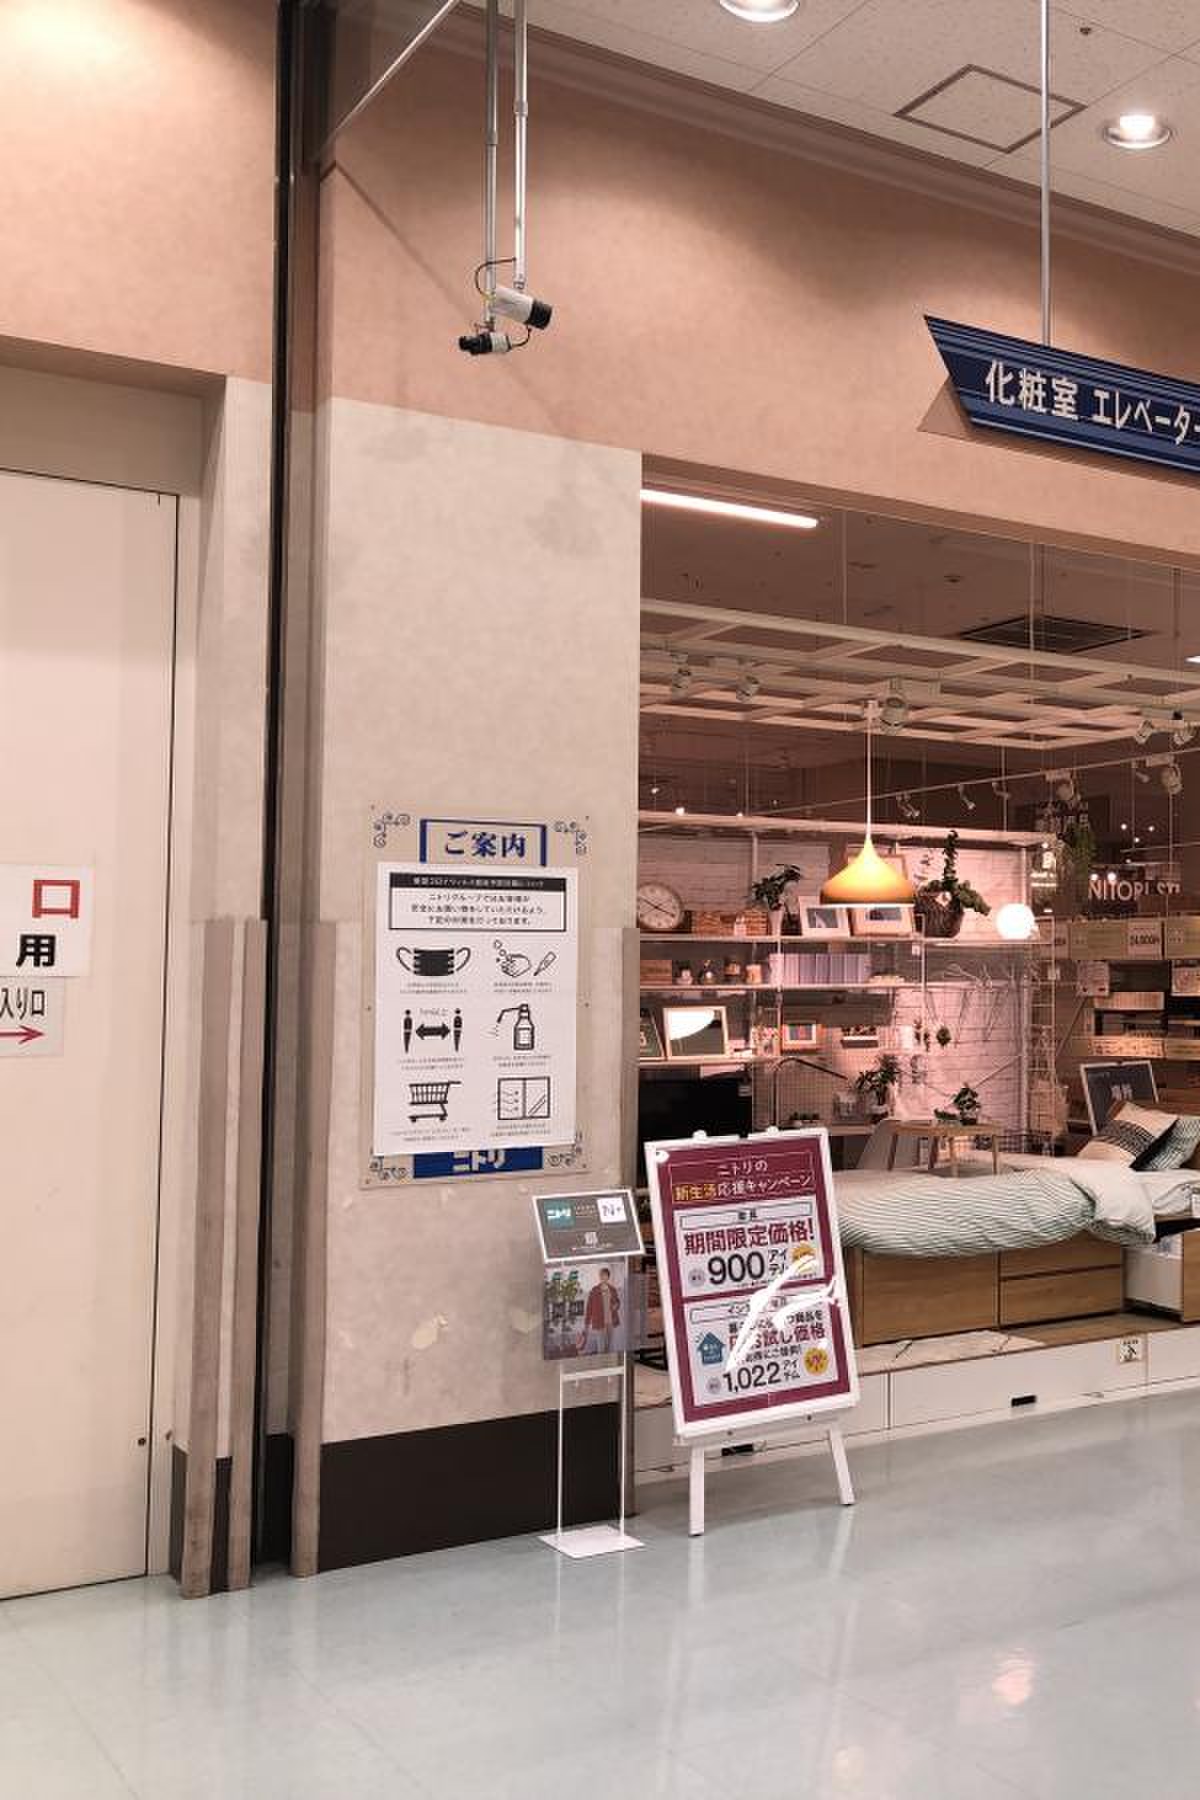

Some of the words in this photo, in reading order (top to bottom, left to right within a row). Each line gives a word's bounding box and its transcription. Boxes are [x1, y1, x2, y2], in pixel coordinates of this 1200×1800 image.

[984, 361, 1077, 421] 化粧室
[445, 831, 527, 859] ご案内
[16, 934, 57, 968] 用
[718, 1160, 768, 1177] ニトリの
[674, 1175, 812, 1201] 新生活応援キャンペーン
[707, 1252, 766, 1285] 900
[723, 1362, 782, 1393] 1,022
